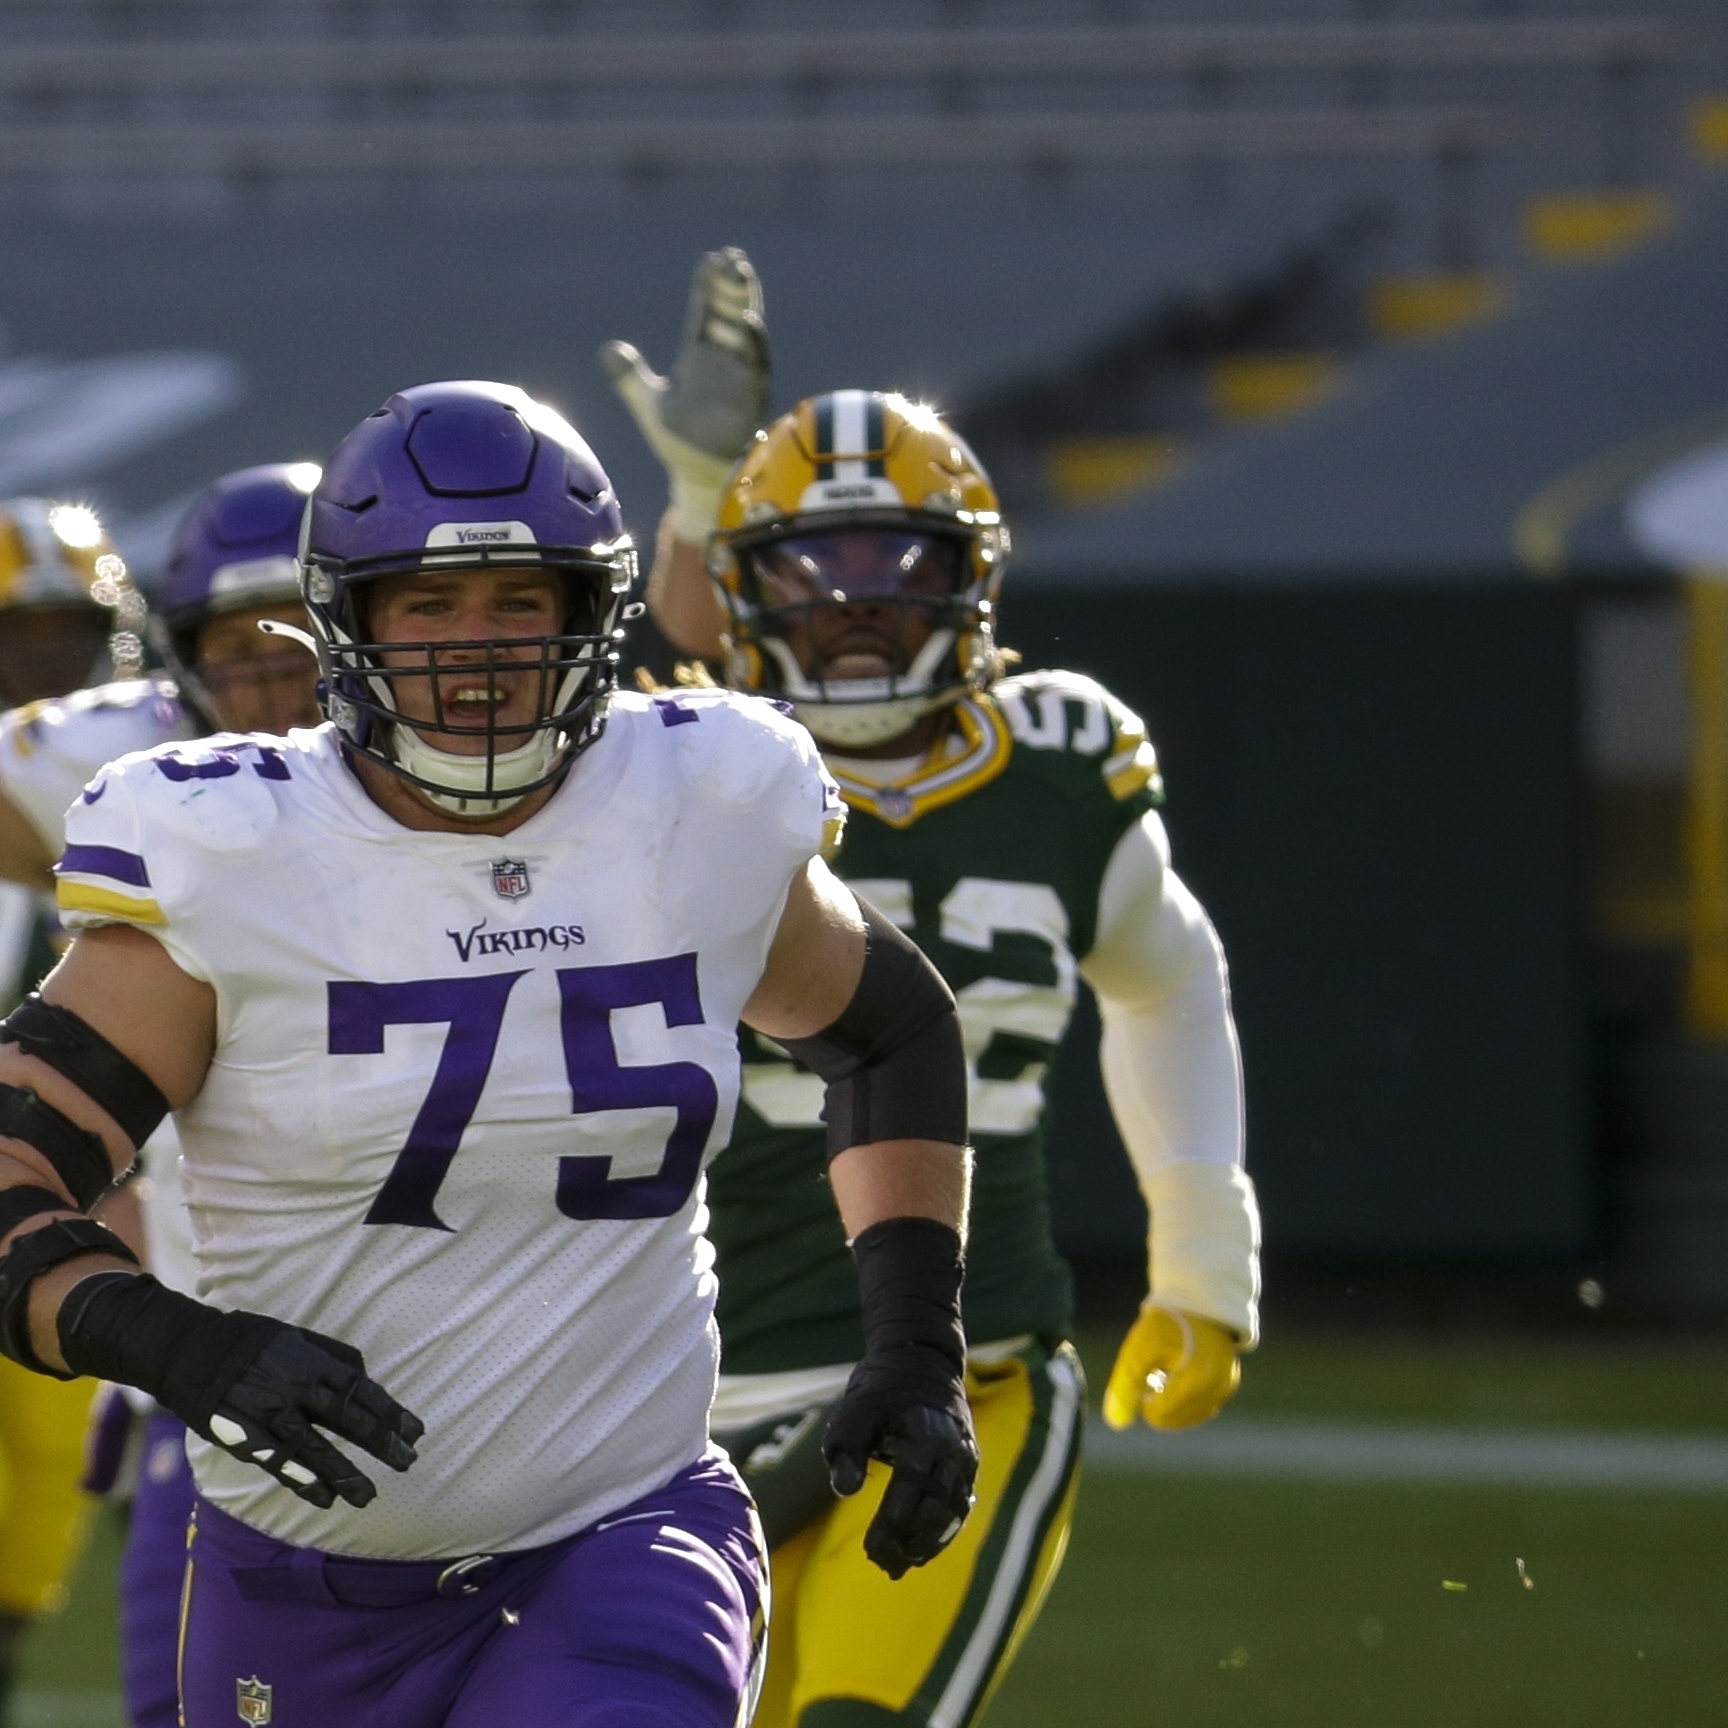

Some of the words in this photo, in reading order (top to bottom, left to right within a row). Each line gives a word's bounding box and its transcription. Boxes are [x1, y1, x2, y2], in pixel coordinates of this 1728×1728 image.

[497, 875, 529, 893] NFL
[446, 917, 587, 963] VIKINGS
[326, 951, 720, 1233] 75
